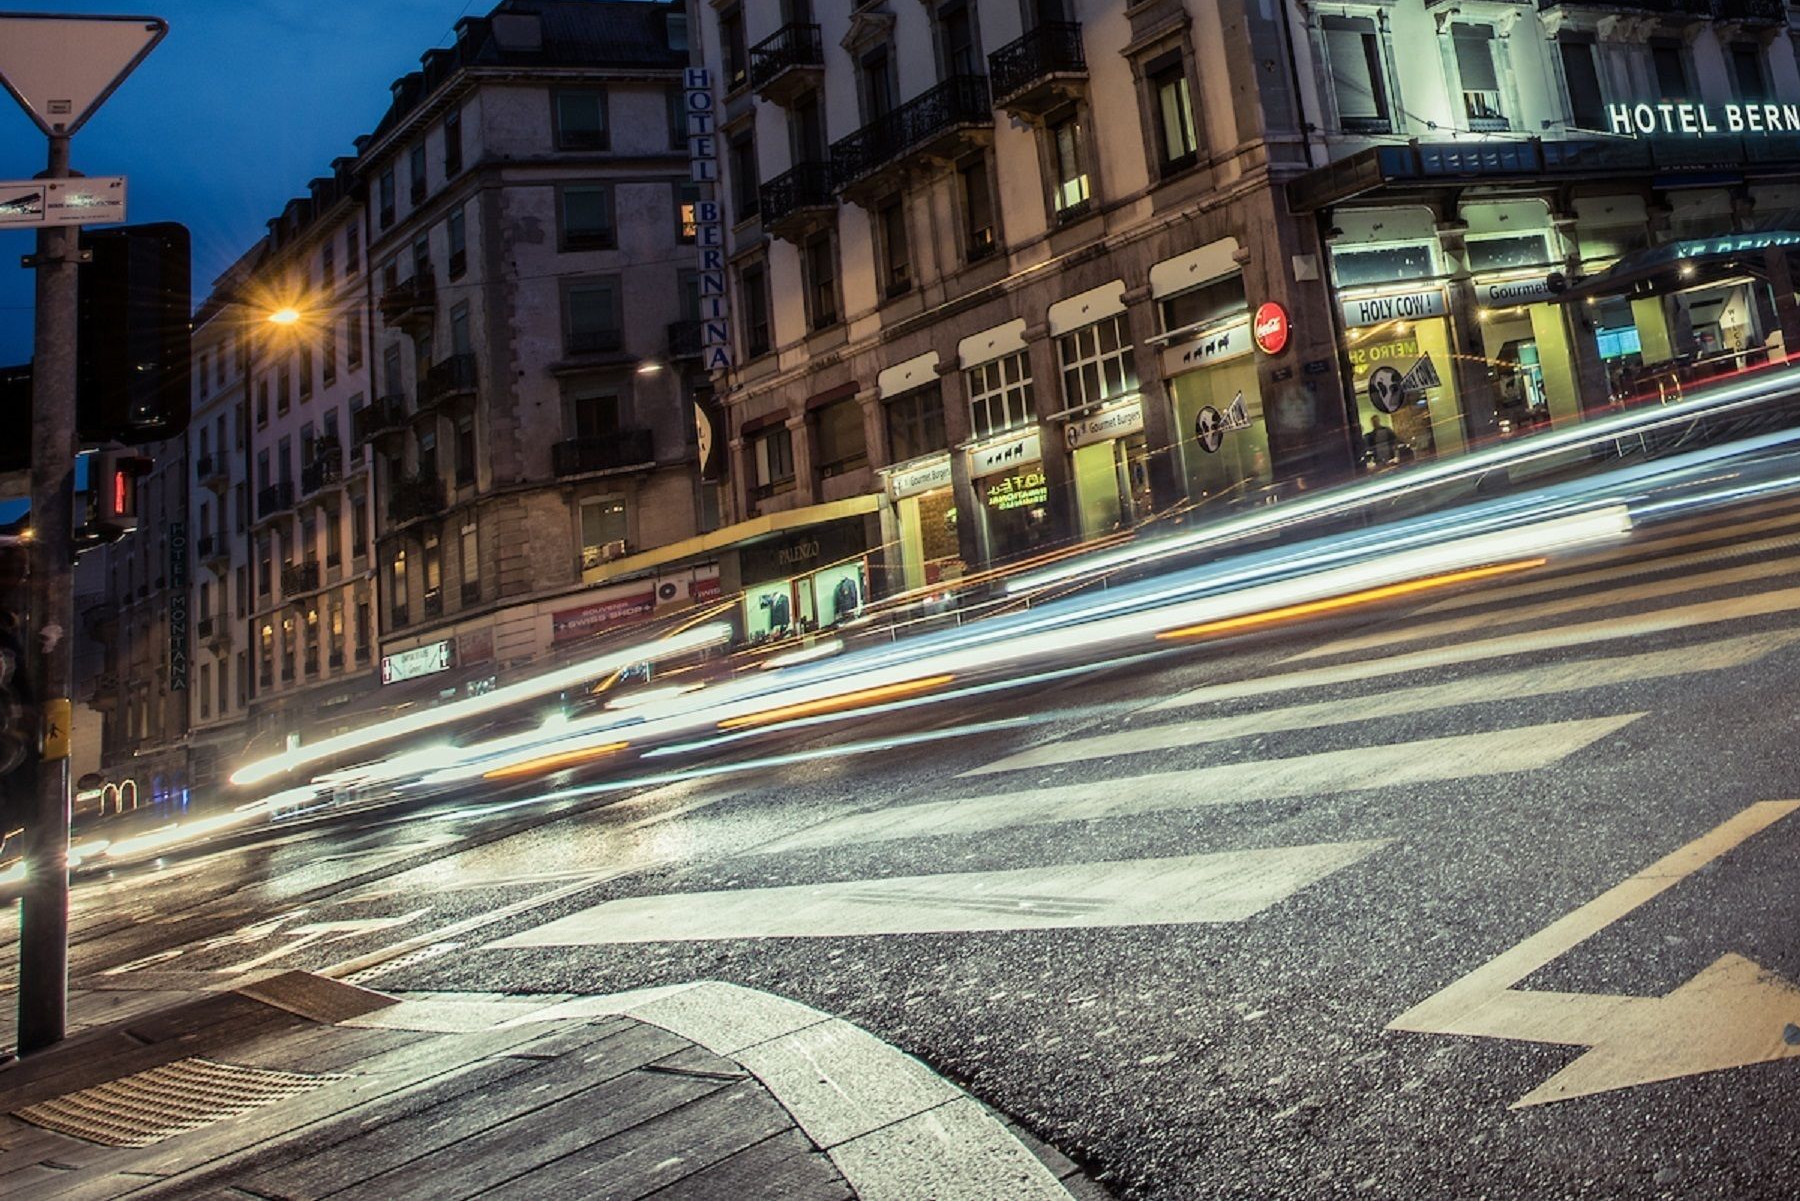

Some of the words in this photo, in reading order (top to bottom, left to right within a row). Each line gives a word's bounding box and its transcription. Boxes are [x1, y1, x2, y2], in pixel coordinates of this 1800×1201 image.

[1609, 103, 1717, 134] HOTEL
[688, 69, 714, 180] HOTEL
[701, 203, 730, 368] BERNINA
[1489, 281, 1550, 300] Gourmet
[1359, 299, 1393, 322] HOLY
[1397, 295, 1424, 317] COW
[1090, 415, 1116, 434] Gourmet
[172, 523, 185, 588] HOTEL
[779, 540, 820, 565] PALENZO
[567, 613, 607, 629] SWISS
[610, 606, 643, 620] SHOP
[582, 602, 629, 617] SOUVENIR
[171, 597, 186, 690] MONTANA
